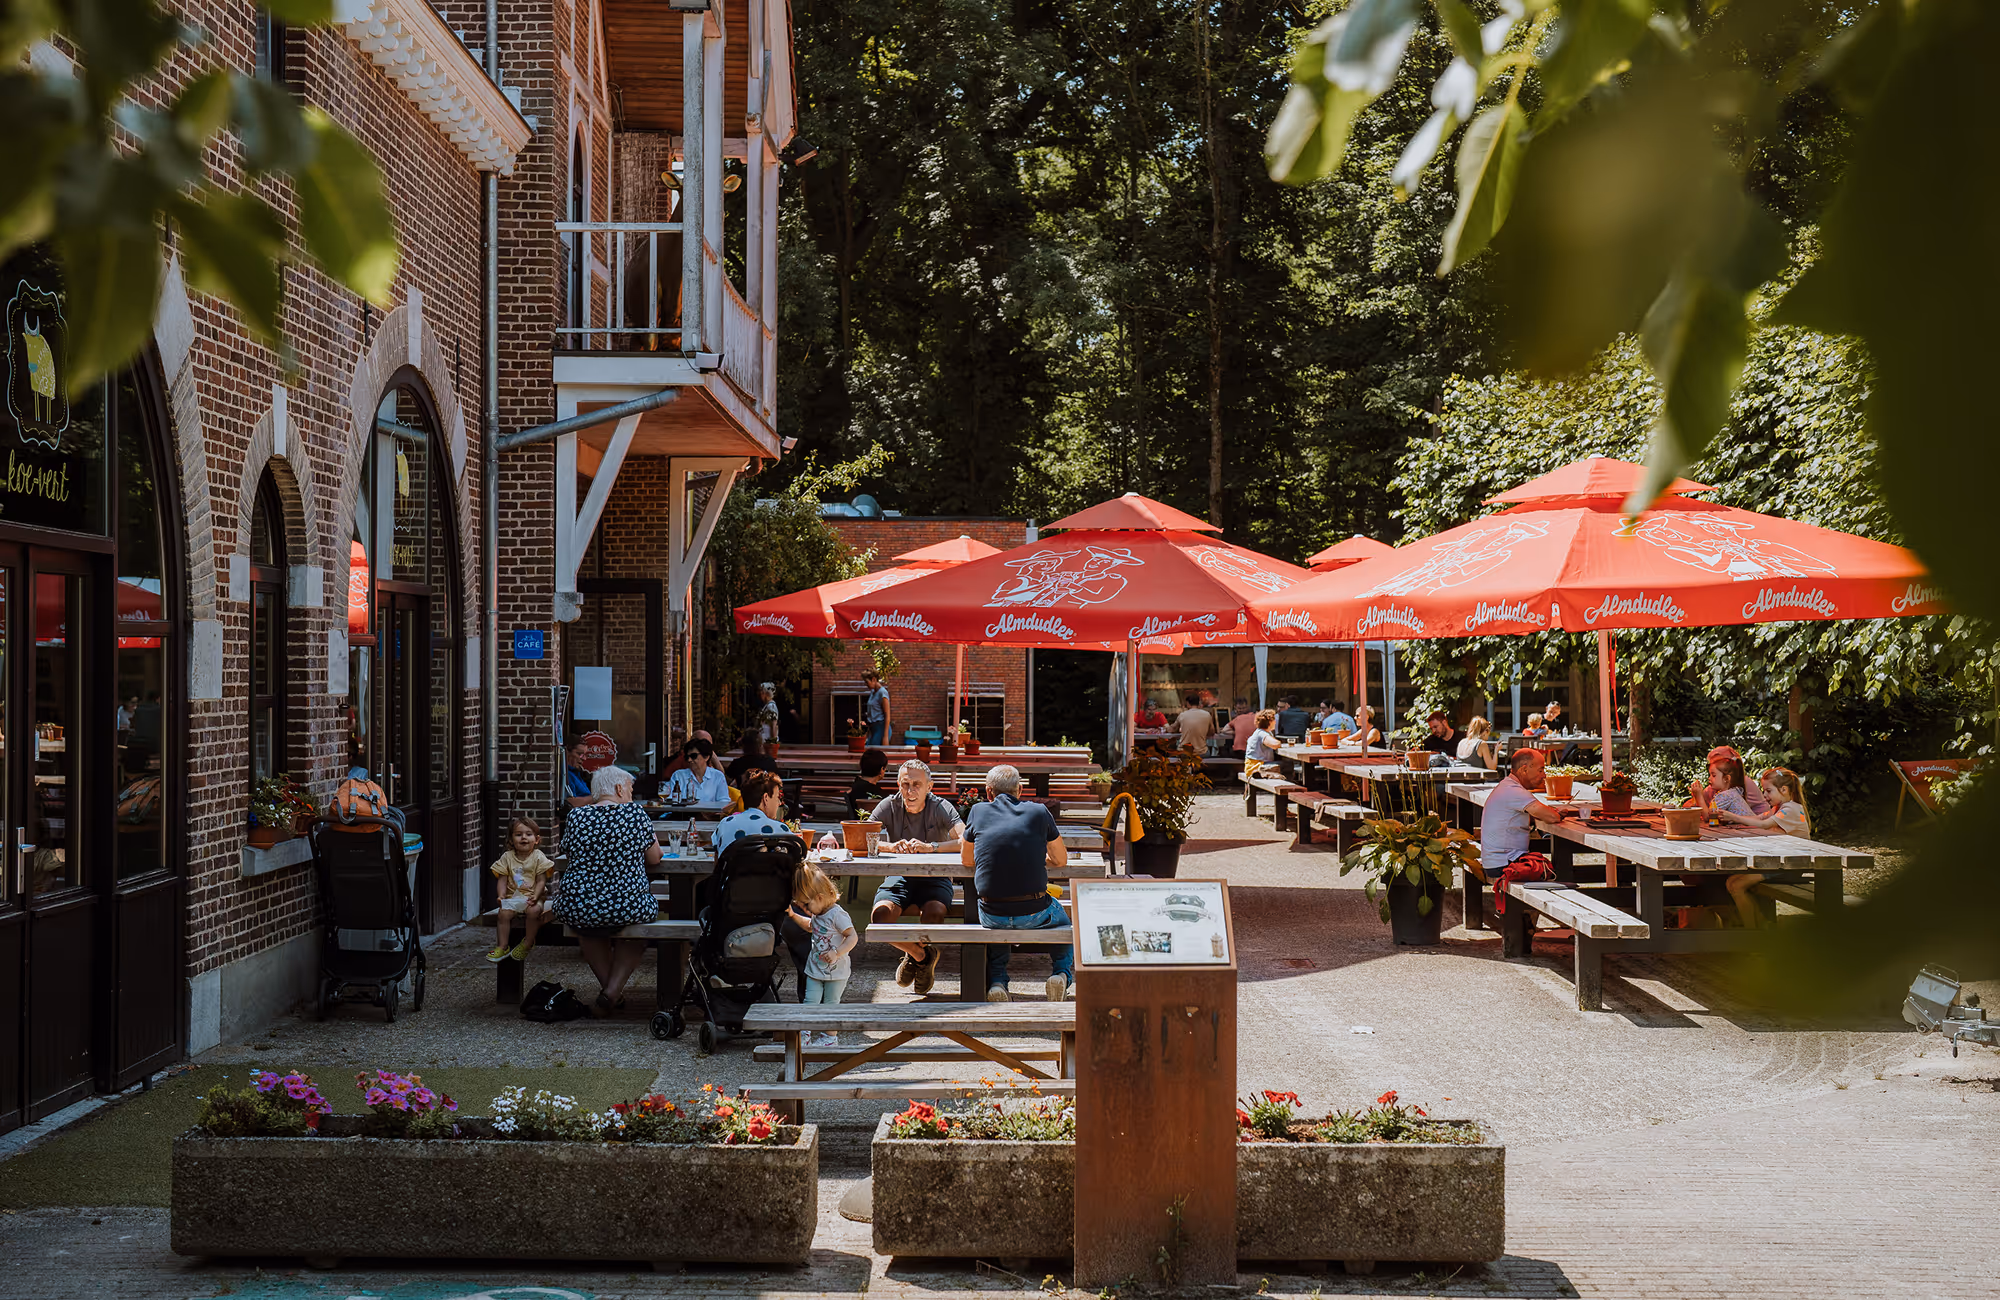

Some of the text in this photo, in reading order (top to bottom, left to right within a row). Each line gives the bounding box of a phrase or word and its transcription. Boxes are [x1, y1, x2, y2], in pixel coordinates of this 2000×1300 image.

[1465, 599, 1546, 631] Almdudler
[1584, 592, 1684, 624] Almdudler
[1742, 585, 1835, 619] Almdudler
[743, 613, 795, 633] Almdudler
[850, 609, 933, 636] Almdudler
[985, 612, 1073, 640] Almdudler
[1262, 608, 1317, 636] Almdudler
[1357, 603, 1424, 634] Almdudler
[517, 639, 541, 649] CAFÉ
[1911, 764, 1958, 777] Almdudler
